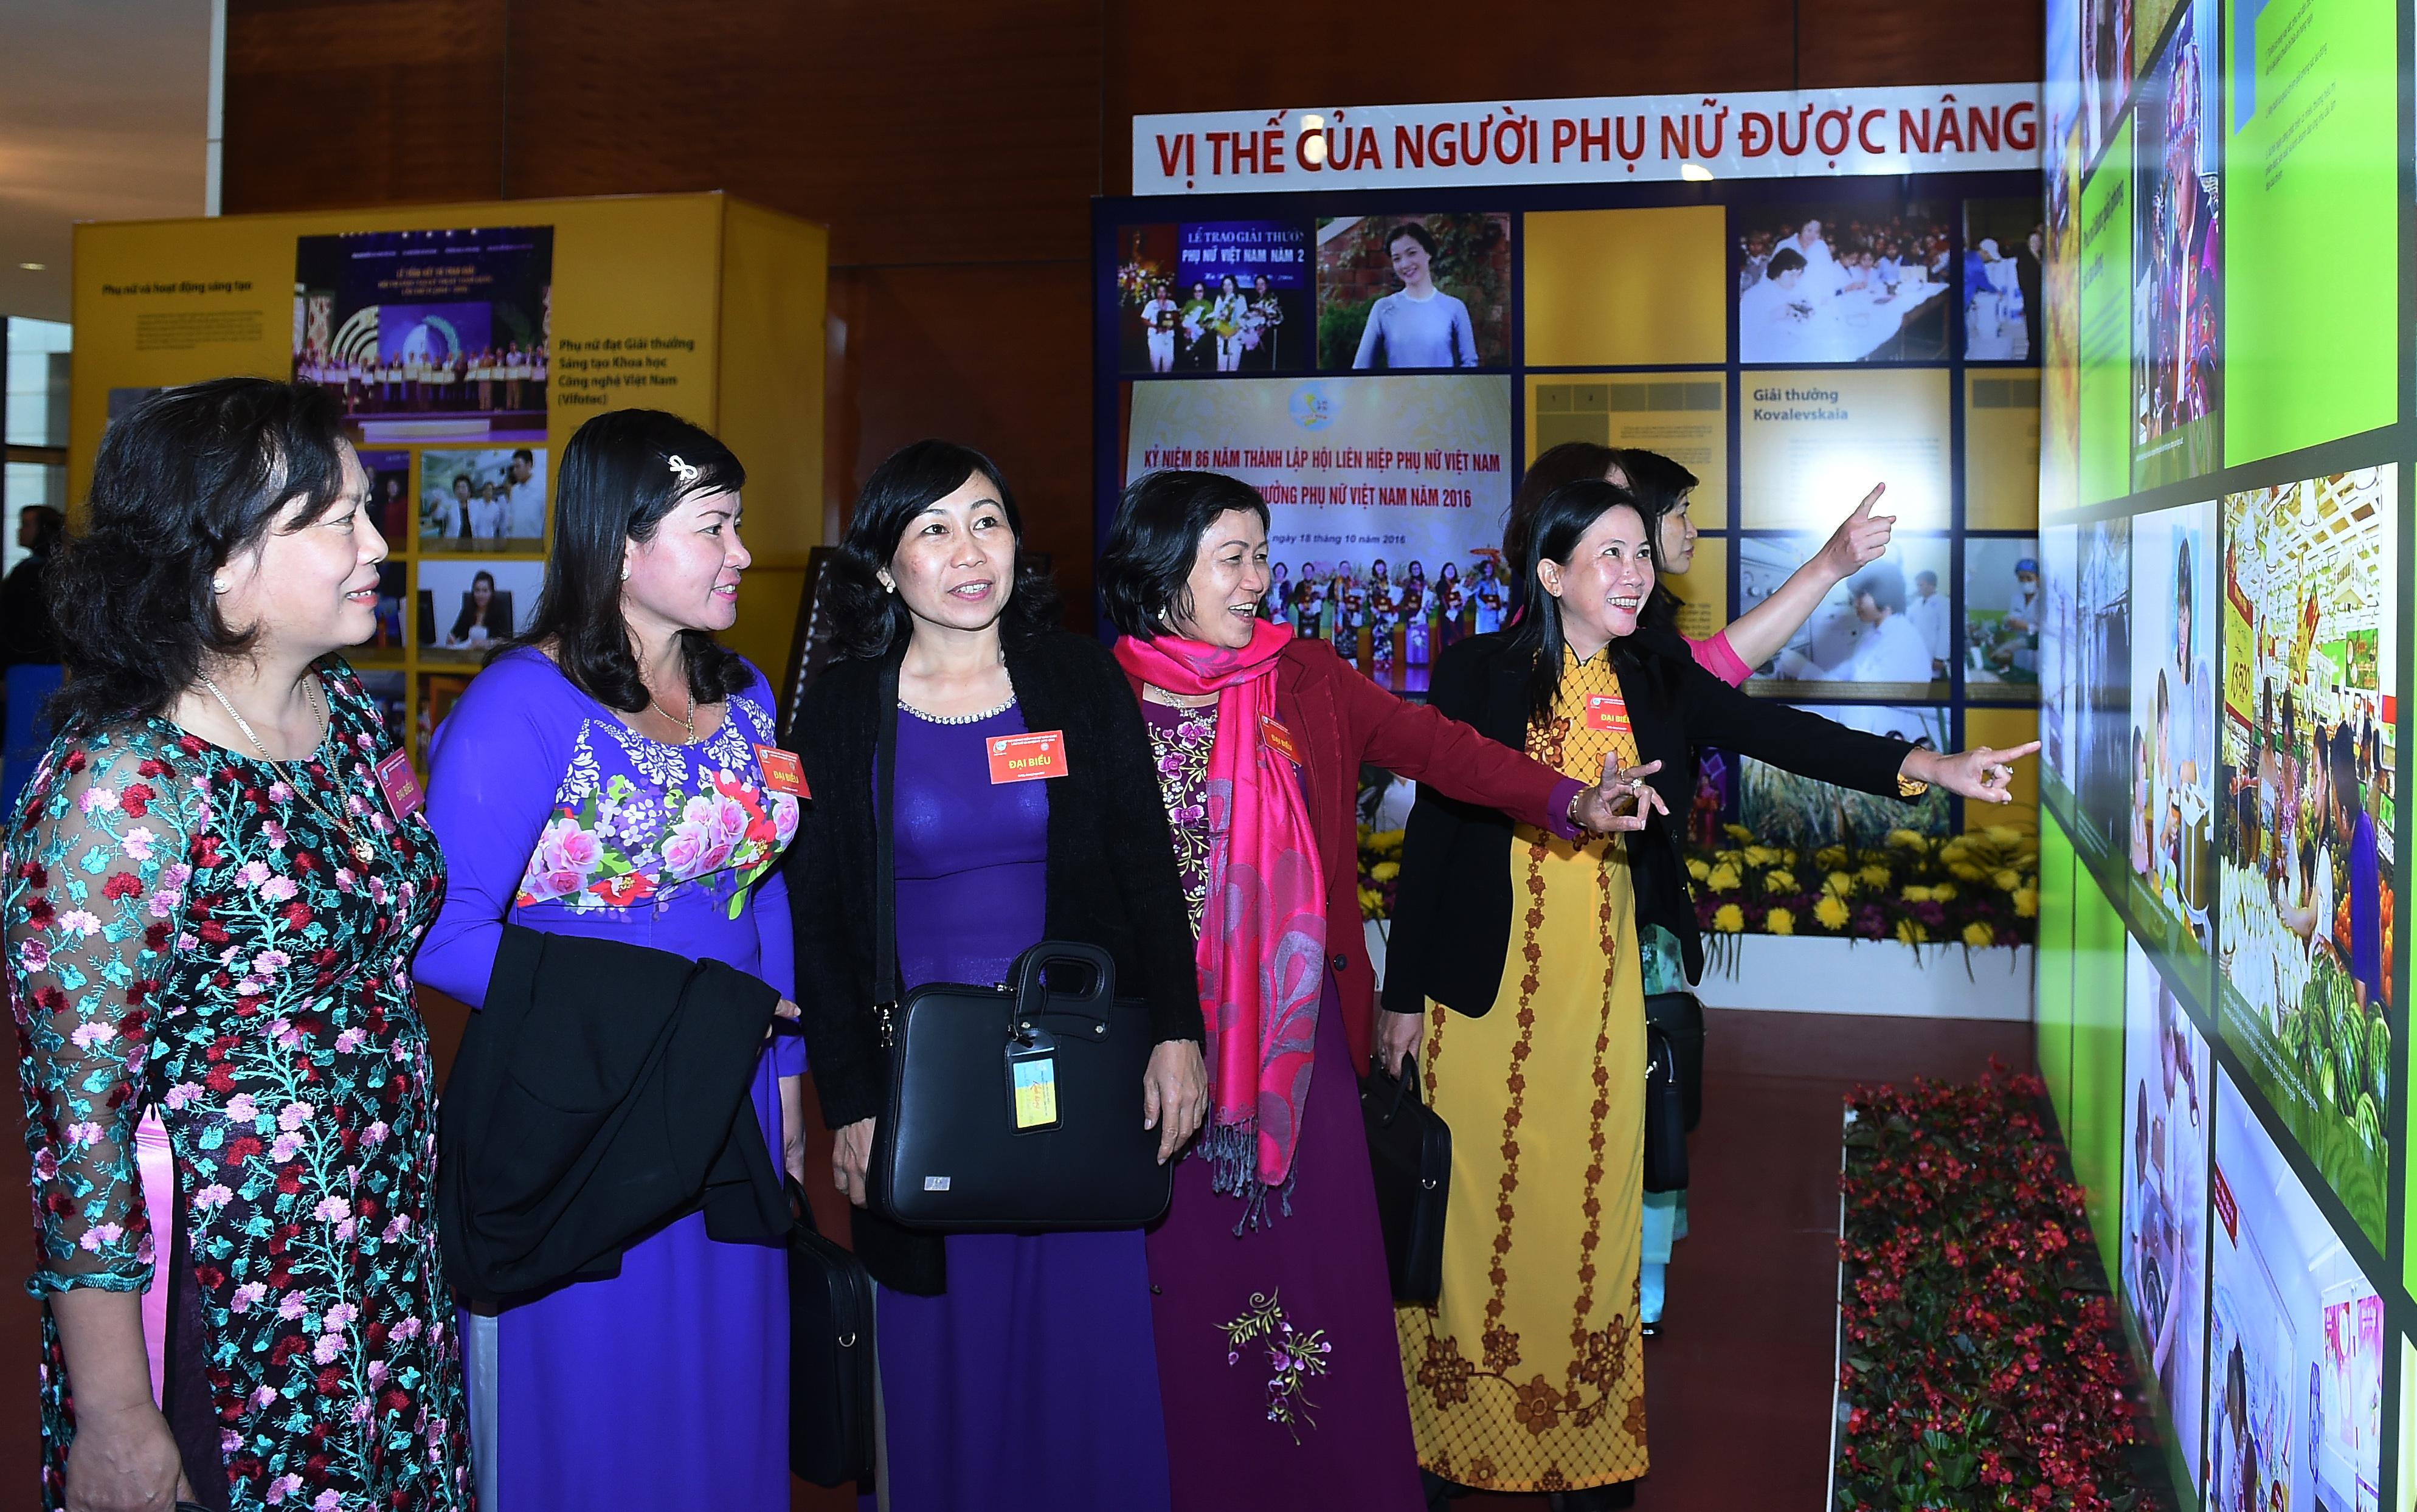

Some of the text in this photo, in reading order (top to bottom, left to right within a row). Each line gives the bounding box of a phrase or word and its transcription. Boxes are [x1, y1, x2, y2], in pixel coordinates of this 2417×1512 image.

[1156, 94, 2035, 188] VỊ THẾ CỦA NGƯỜI PHỤ NỮ ĐƯỢC NÂNG
[1204, 231, 1235, 243] TRAO
[1236, 227, 1262, 243] GIẢI
[1182, 249, 1200, 264] PHỤ
[1221, 246, 1241, 264] VIỆT
[1243, 249, 1267, 263] NAM
[1271, 246, 1293, 263] NĂM
[559, 339, 581, 352] Phụ
[559, 356, 666, 370] Sáng tạo Khoa học
[558, 375, 588, 388] Công
[624, 373, 647, 387] Việt
[650, 374, 677, 385] Nam
[1754, 387, 1839, 404] Giải thưởng
[1754, 408, 1849, 420] Kovalevskaia
[1163, 446, 1191, 469] NIỆM
[1195, 450, 1209, 468] 86
[1213, 447, 1240, 468] NĂM
[1244, 446, 1282, 468] THÀNH
[1286, 446, 1308, 472] LẬP
[1312, 446, 1332, 472] HỘI
[1336, 446, 1362, 469] LIÊN
[1366, 447, 1393, 473] HIỆP
[1397, 451, 1420, 474] PHỤ
[1425, 449, 1443, 471] NỮ
[1445, 449, 1469, 475] VIỆT
[1473, 453, 1500, 472] NAM
[1301, 486, 1325, 509] PHỤ
[1329, 483, 1347, 505] NỮ
[1350, 483, 1375, 509] VIỆT
[1379, 487, 1407, 506] NAM
[1411, 485, 1439, 506] NĂM
[1443, 489, 1471, 508] 2016
[1273, 534, 1406, 545] ngày 18 tháng 10 năm 2016
[1600, 714, 1614, 723] ĐẠI
[1009, 754, 1051, 770] ĐẠI BIỂU
